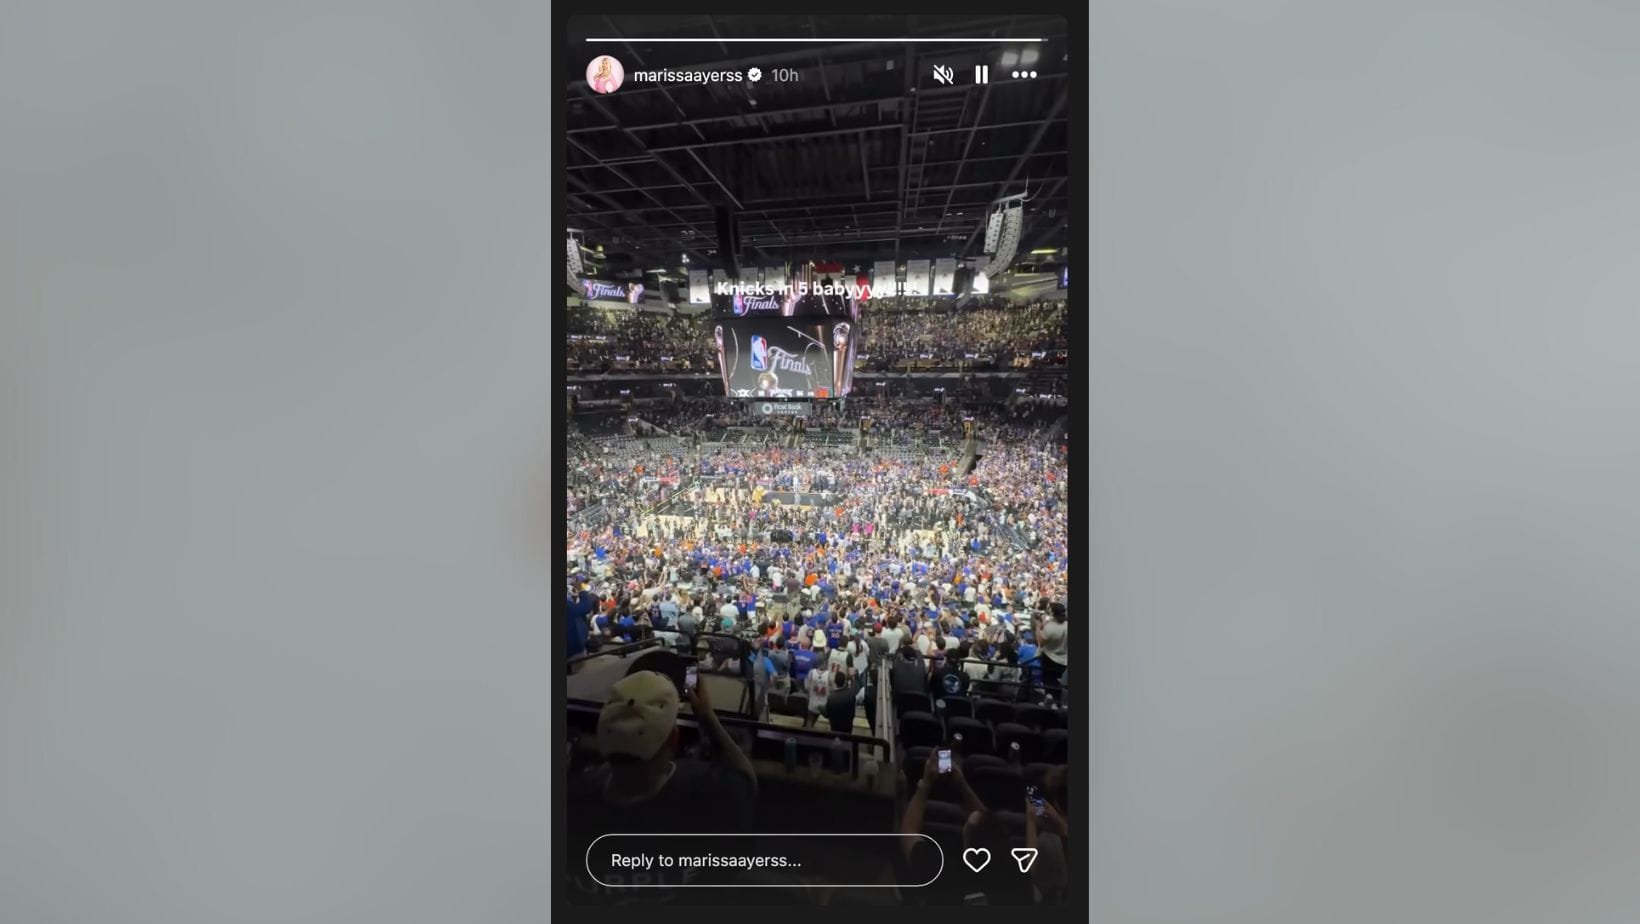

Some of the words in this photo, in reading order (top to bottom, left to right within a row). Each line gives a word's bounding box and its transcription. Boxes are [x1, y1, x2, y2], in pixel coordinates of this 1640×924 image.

[592, 282, 626, 300] Finals
[739, 294, 780, 317] Finals
[767, 345, 812, 375] Finals
